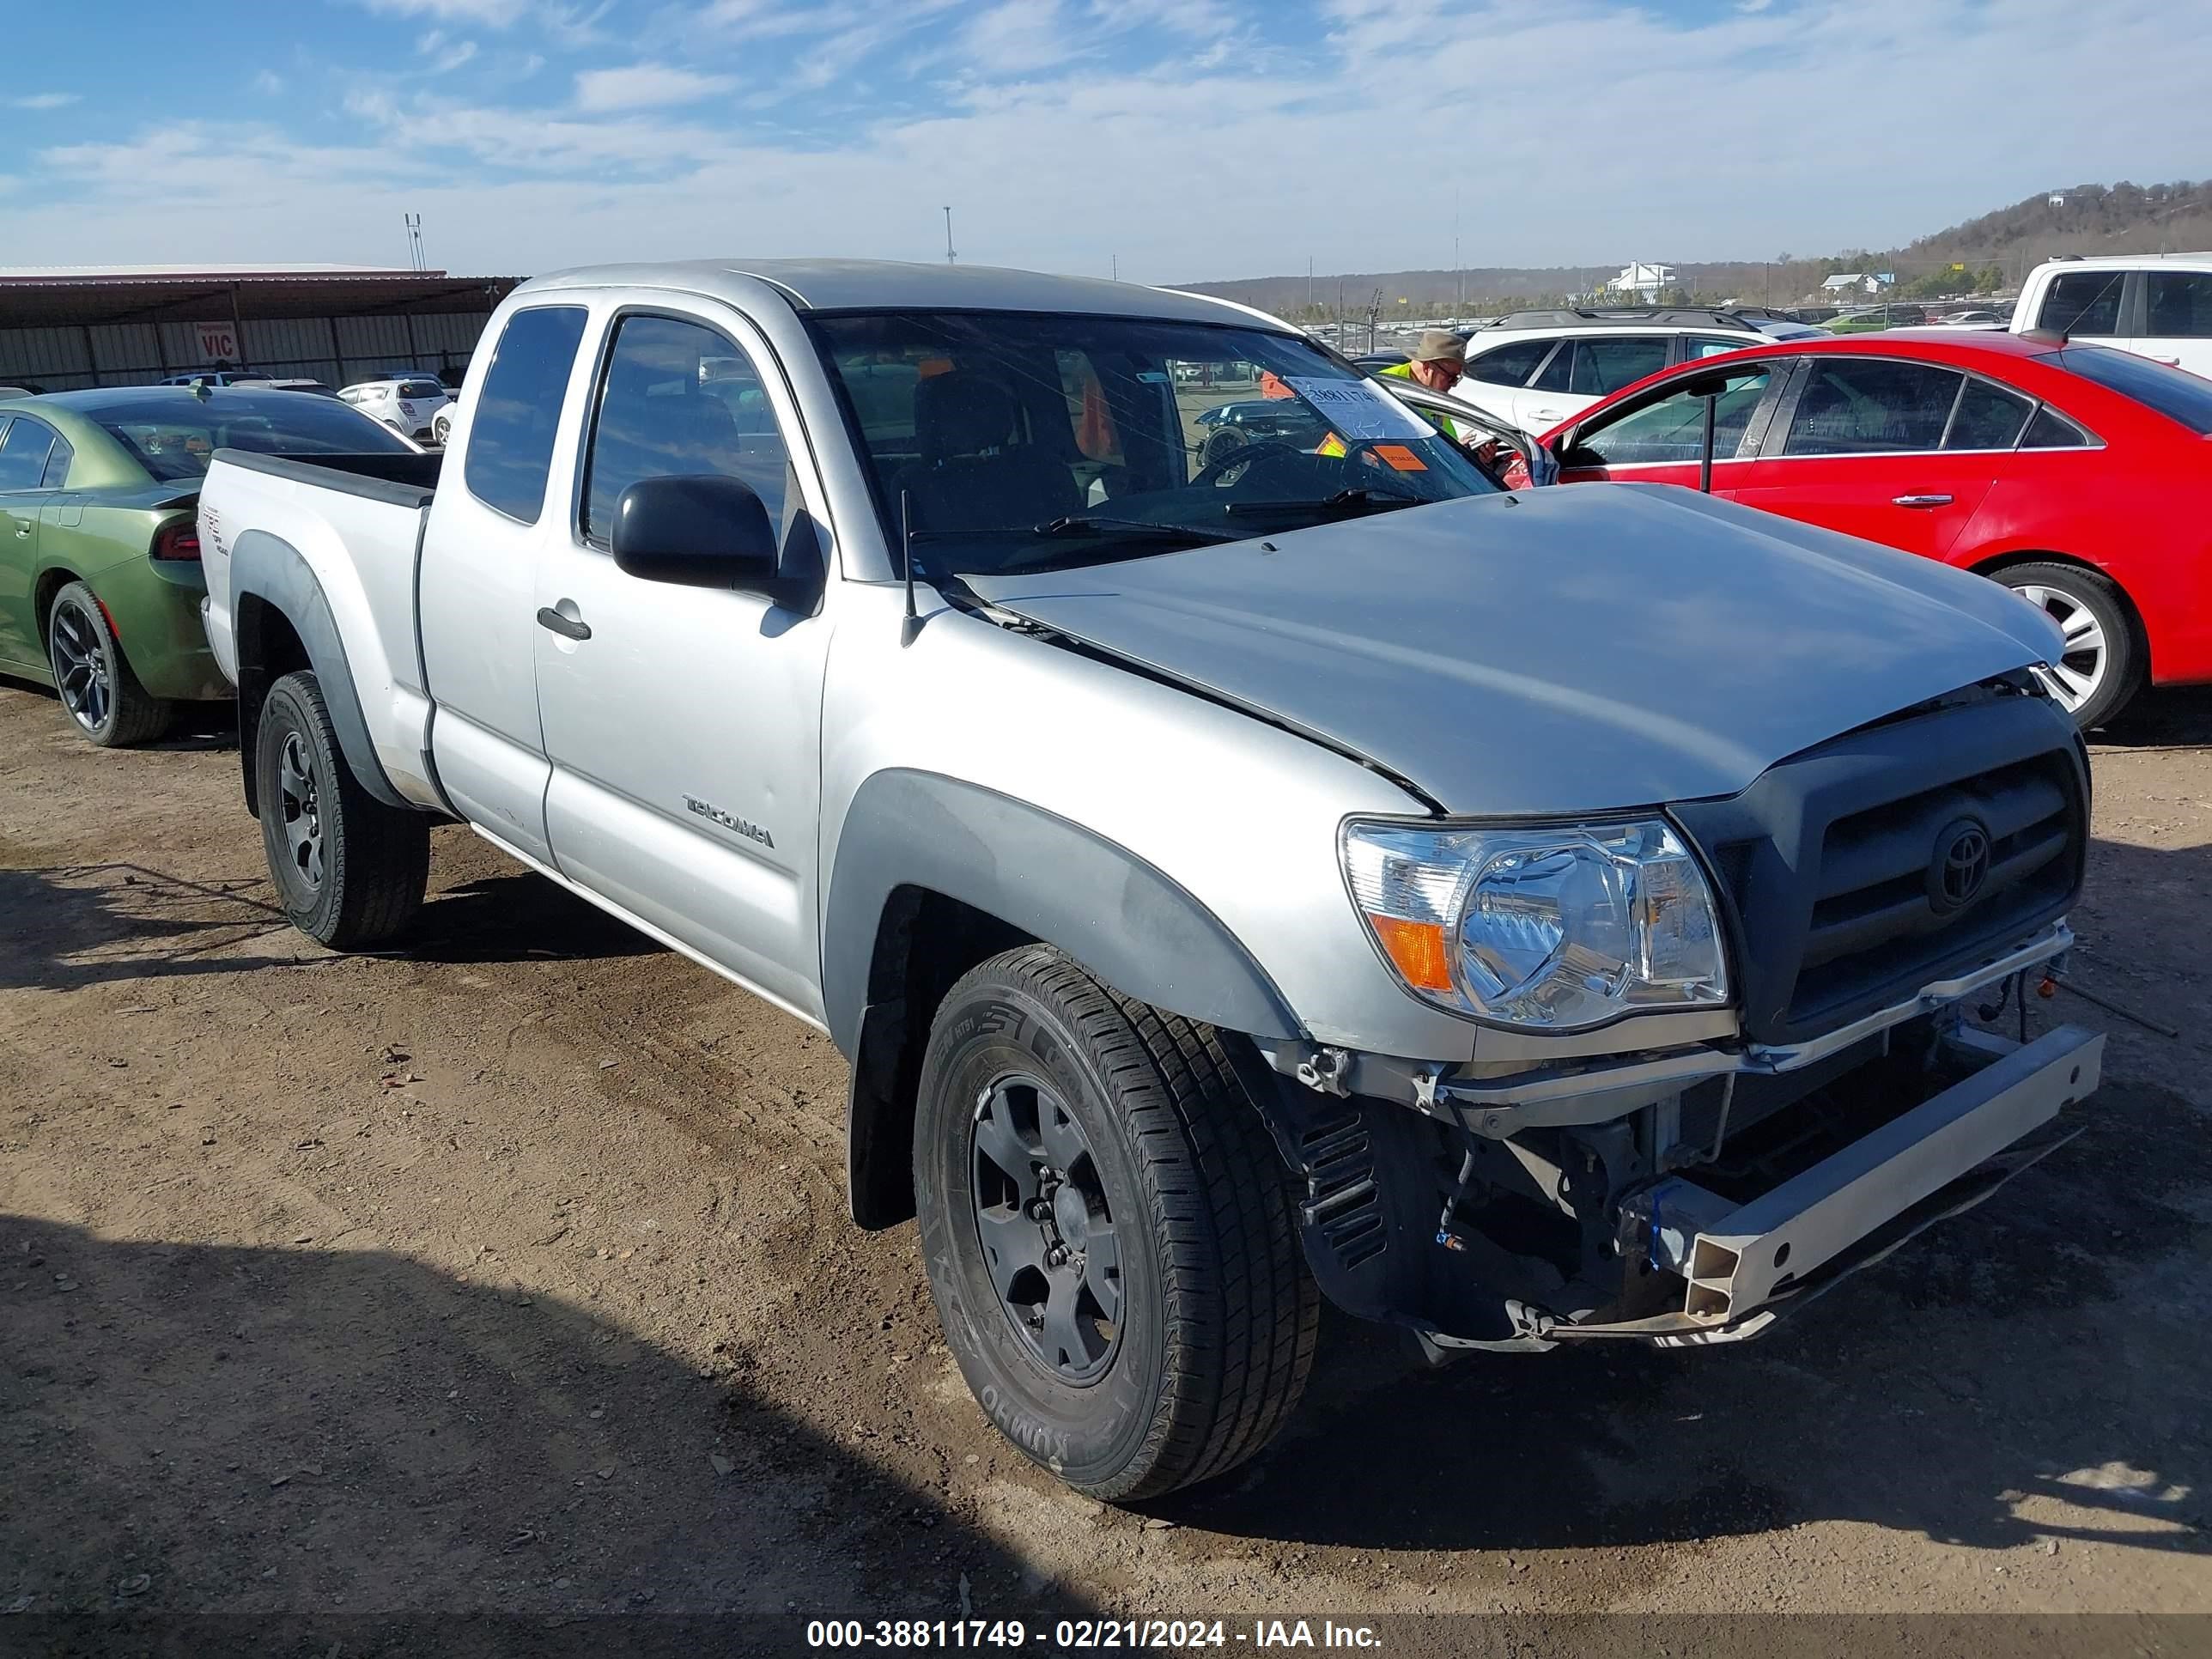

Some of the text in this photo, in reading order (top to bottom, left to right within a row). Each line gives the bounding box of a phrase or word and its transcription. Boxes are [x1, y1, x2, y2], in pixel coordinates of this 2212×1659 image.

[202, 335, 234, 357] VIC
[682, 794, 775, 849] TACOMA
[981, 1384, 1069, 1462] KUMHO
